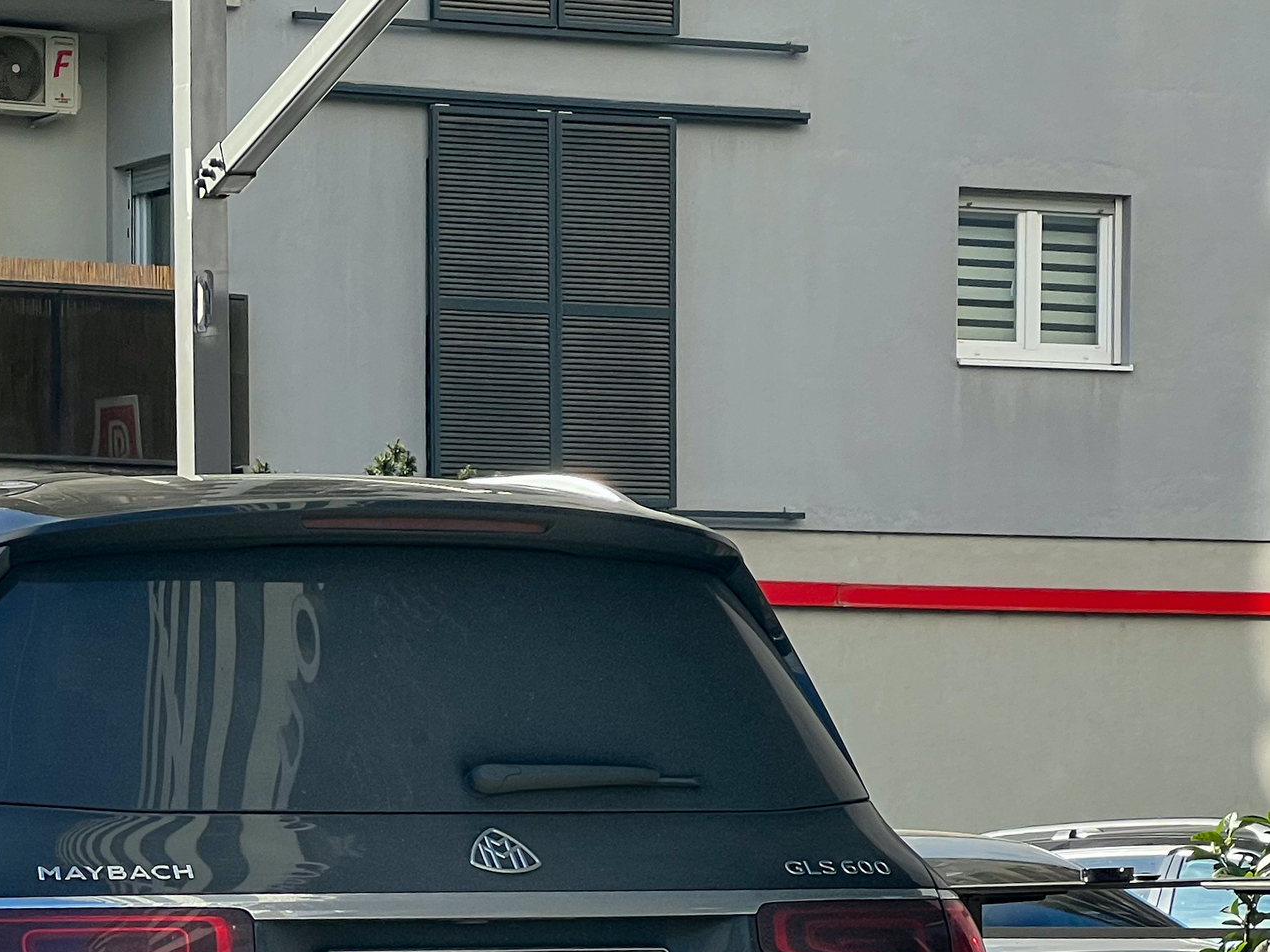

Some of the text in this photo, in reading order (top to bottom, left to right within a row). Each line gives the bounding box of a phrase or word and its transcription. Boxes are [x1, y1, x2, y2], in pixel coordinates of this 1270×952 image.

[37, 864, 195, 881] MAYBACH
[785, 860, 891, 875] GLS 600
